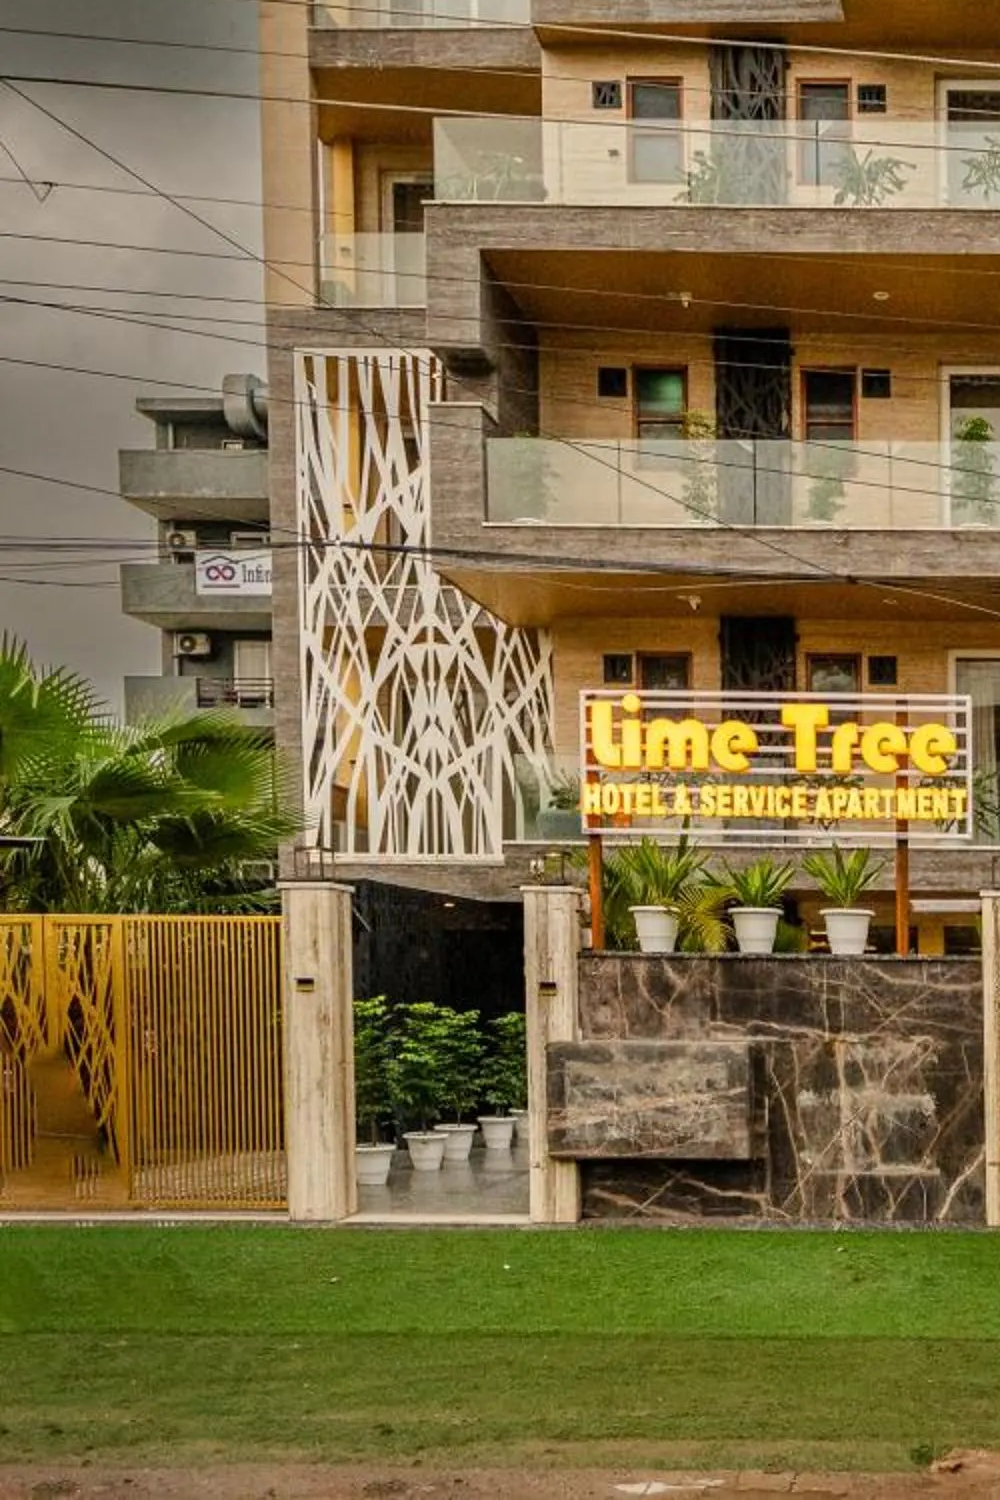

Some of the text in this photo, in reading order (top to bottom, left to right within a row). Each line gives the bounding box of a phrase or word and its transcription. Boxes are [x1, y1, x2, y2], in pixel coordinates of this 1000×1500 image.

[588, 692, 957, 775] Lime Tree
[581, 782, 967, 821] HOTEL & SERVICE APARTMENT
